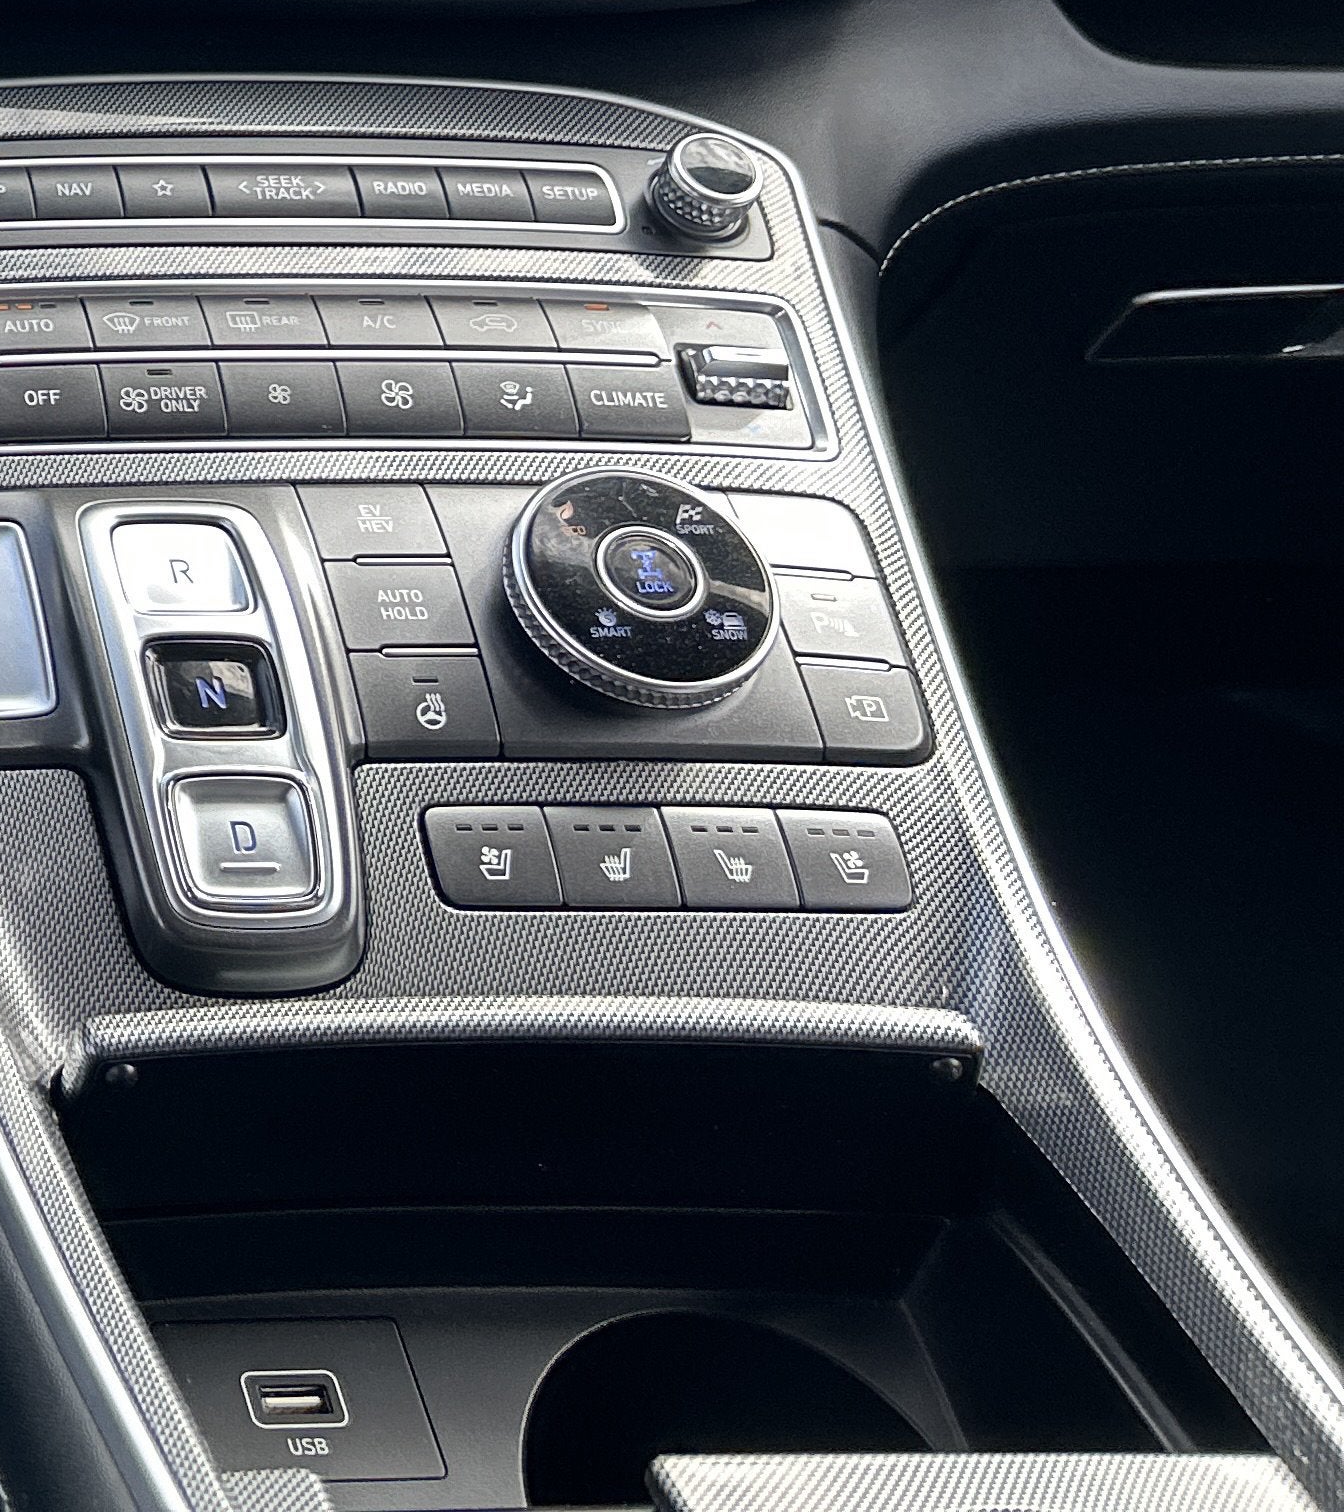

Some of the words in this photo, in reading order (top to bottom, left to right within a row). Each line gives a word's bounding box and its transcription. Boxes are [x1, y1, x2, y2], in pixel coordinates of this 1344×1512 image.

[257, 175, 304, 188] SEEK
[373, 180, 427, 196] RADIO
[57, 183, 92, 198] NAV
[254, 187, 315, 200] TRACK
[458, 183, 514, 198] MEDIA
[542, 186, 598, 201] SETUP
[5, 319, 54, 334] AUTO
[144, 315, 190, 328] FRONT
[263, 314, 299, 327] REAR
[363, 313, 396, 329] A/C
[24, 390, 61, 406] OFF
[151, 386, 208, 401] DRIVER
[590, 391, 668, 408] CLIMATE
[161, 398, 201, 413] ONLY
[358, 504, 381, 517] EV
[358, 519, 394, 534] HEV
[677, 524, 715, 535] SPORT
[171, 558, 194, 584] R
[636, 581, 674, 593] LOCK
[377, 589, 423, 604] AUTO
[380, 604, 429, 621] HOLD
[590, 626, 632, 638] SMART
[712, 629, 747, 641] SNOW
[196, 676, 228, 710] N
[232, 820, 258, 854] D
[286, 1438, 329, 1456] USB
